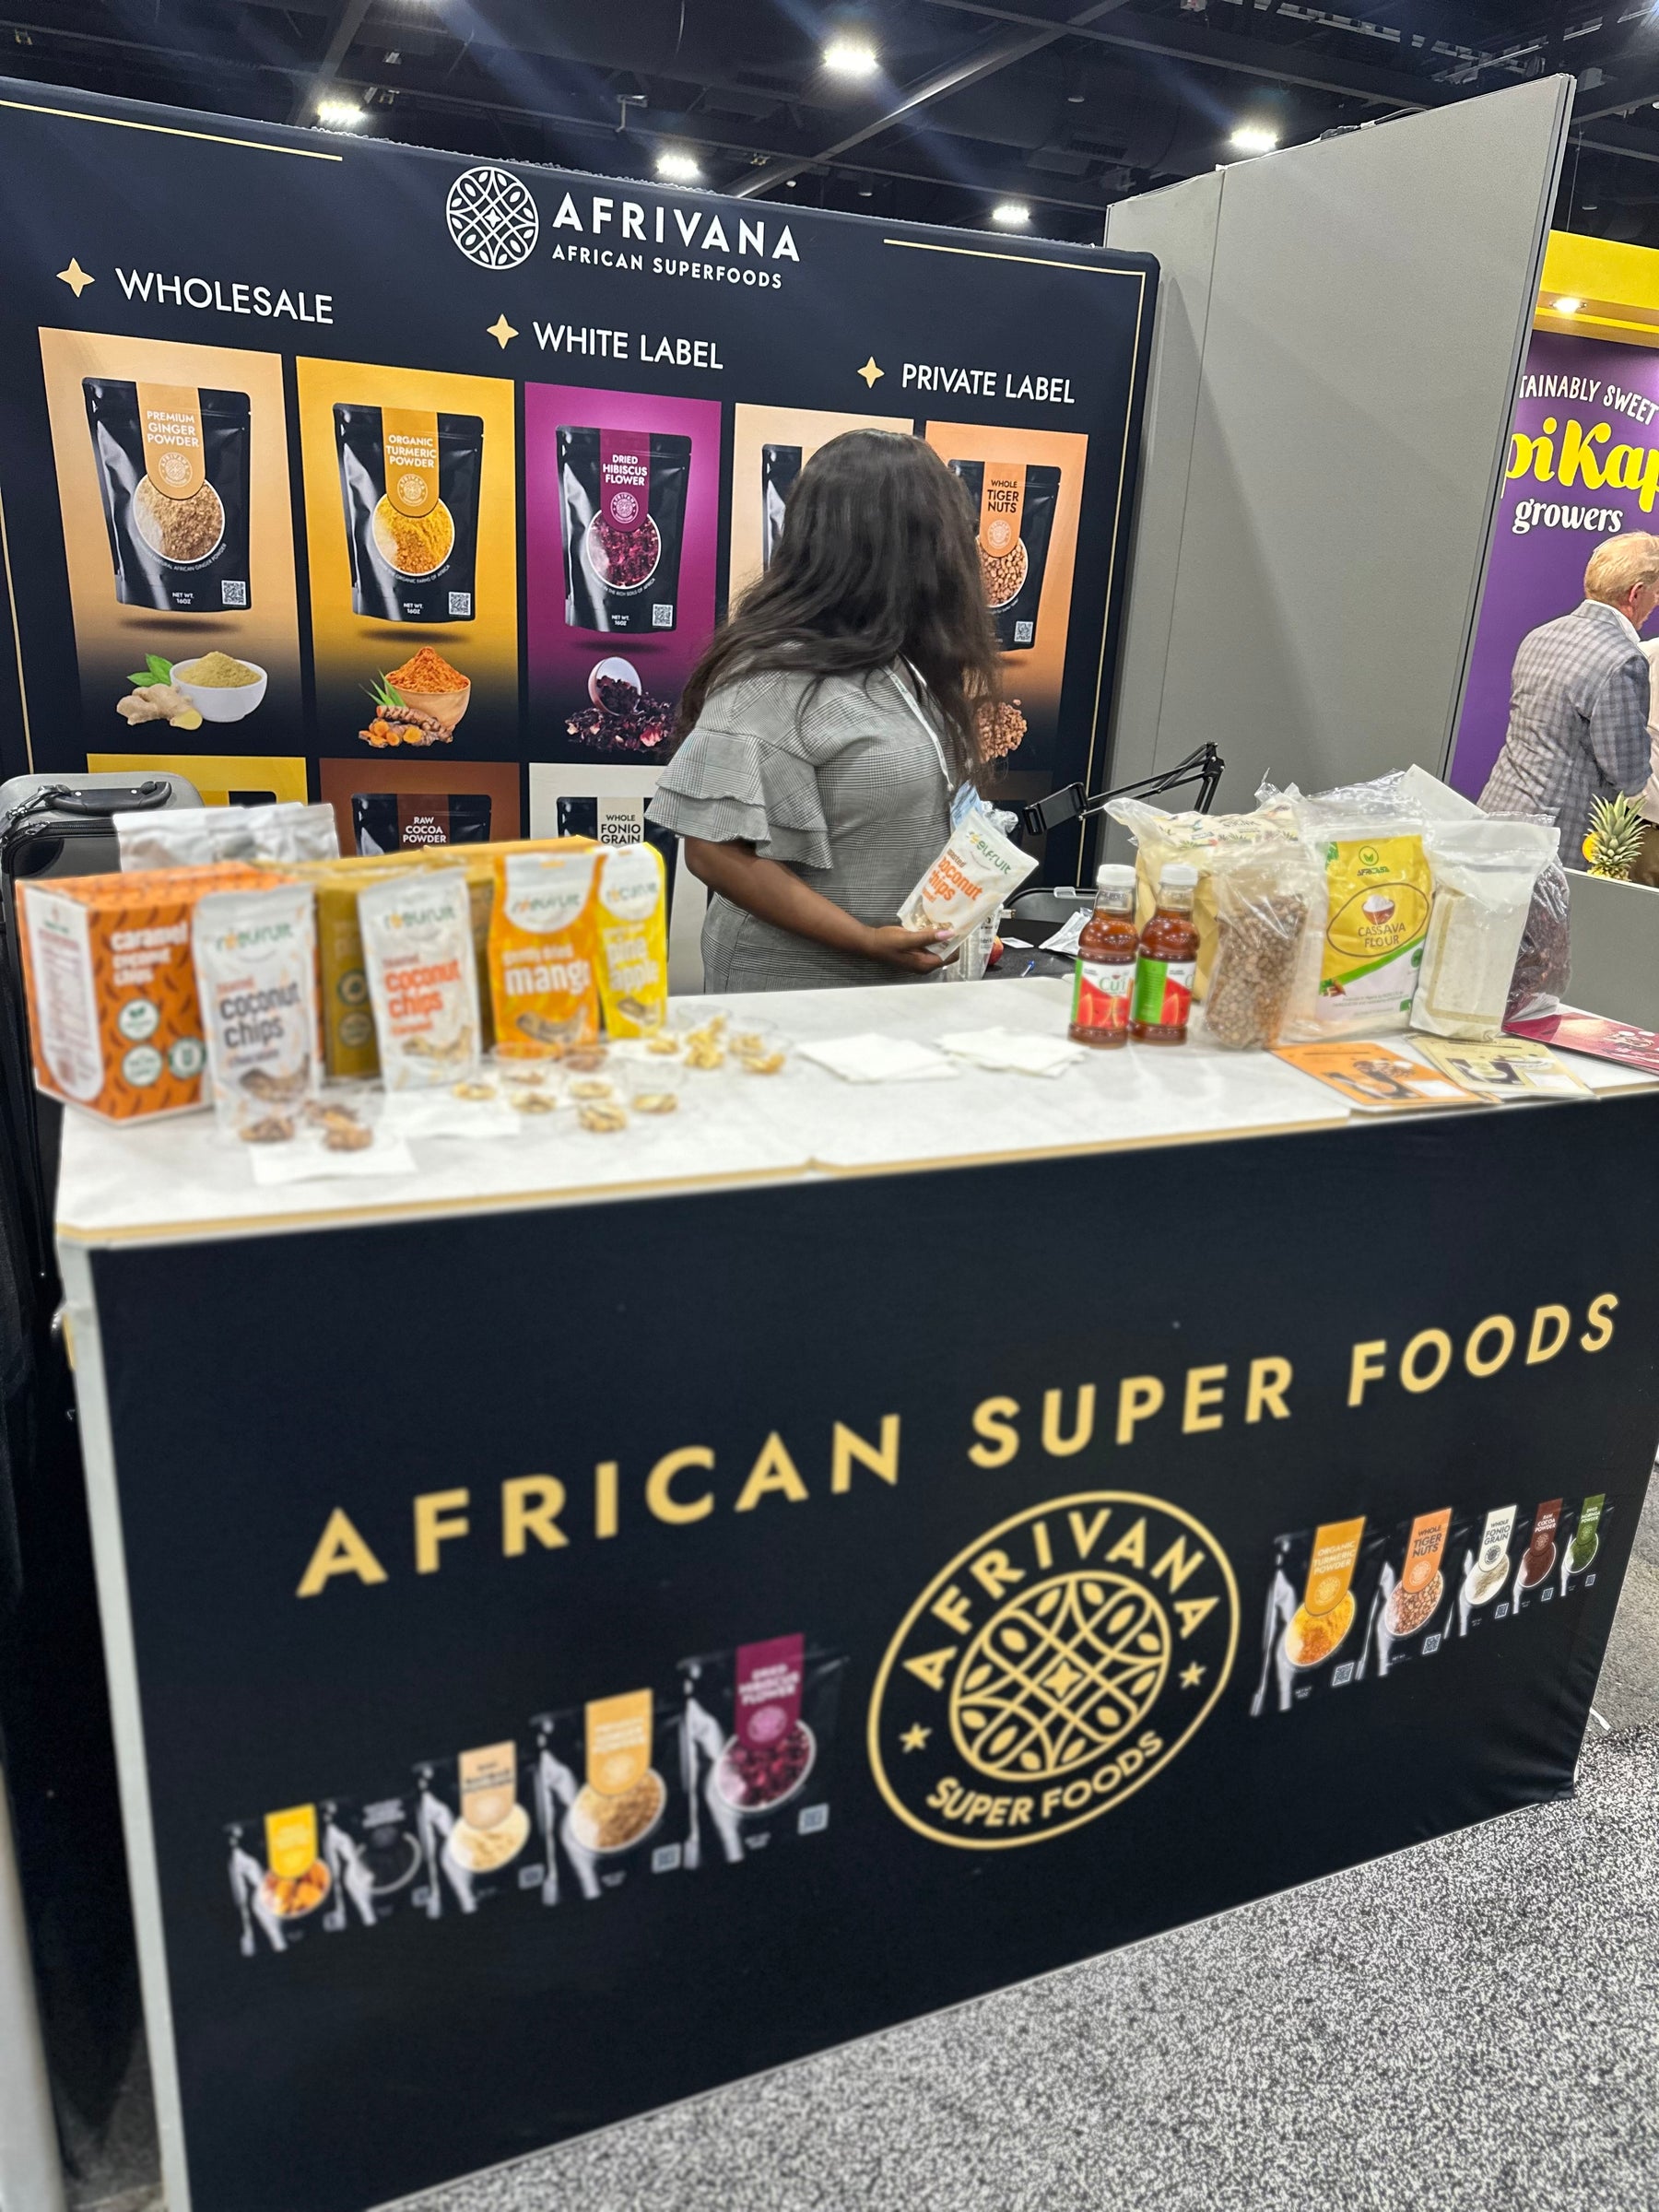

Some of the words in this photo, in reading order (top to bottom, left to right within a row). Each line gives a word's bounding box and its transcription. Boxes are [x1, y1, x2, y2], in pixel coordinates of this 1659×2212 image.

[552, 192, 800, 262] AFRIVANA
[552, 244, 643, 270] AFRICAN
[653, 257, 782, 288] SUPERFOODS
[115, 267, 334, 324] WHOLESALE
[533, 321, 629, 359] WHITE
[640, 334, 724, 370] LABEL
[901, 363, 997, 396] PRIVATE
[1006, 373, 1075, 404] LABEL
[1603, 384, 1659, 426] SWEET
[147, 410, 195, 424] PREMIUM
[147, 422, 196, 436] GINGER
[147, 434, 200, 448] POWDER
[388, 434, 433, 447] ORGANIC
[385, 445, 438, 458] TURMERIC
[389, 456, 435, 468] POWDER
[612, 454, 639, 465] DRIED
[603, 464, 648, 477] HIBISCUS
[605, 474, 645, 487] FLOWER
[991, 480, 1018, 488] WHOLE
[987, 489, 1019, 501] TIGER
[987, 501, 1017, 513] NUTS
[1512, 499, 1623, 534] growers
[414, 817, 434, 826] RAW
[606, 814, 636, 822] WHOLE
[406, 825, 443, 835] COCOA
[601, 824, 641, 835] FONIO
[403, 834, 447, 844] POWDER
[601, 833, 641, 845] GRAIN
[1359, 922, 1406, 937] CASSAVA
[1364, 934, 1400, 948] FLOUR
[383, 959, 460, 994] coconut
[218, 982, 301, 1020] coconut
[387, 991, 444, 1021] chips
[222, 1016, 285, 1049] chips
[297, 1414, 900, 1597] AFRICAN
[968, 1357, 1292, 1468] SUPER
[1347, 1293, 1618, 1406] FOODS
[1490, 1519, 1509, 1528] WHOLE
[1535, 1523, 1557, 1533] POWDER
[1536, 1518, 1556, 1527] COCOA
[1418, 1524, 1441, 1537] WHOLE
[1485, 1524, 1511, 1538] FONIO
[1413, 1533, 1441, 1547] TIGER
[1484, 1533, 1509, 1546] GRAIN
[1318, 1540, 1356, 1557] ORGANIC
[1412, 1543, 1439, 1559] NUTS
[1313, 1549, 1356, 1567] TURMERIC
[1313, 1559, 1352, 1575] POWDER
[902, 1508, 1220, 1691] AFRIVANA
[926, 1776, 1034, 1827] SUPER
[1040, 1730, 1164, 1818] FOODS
